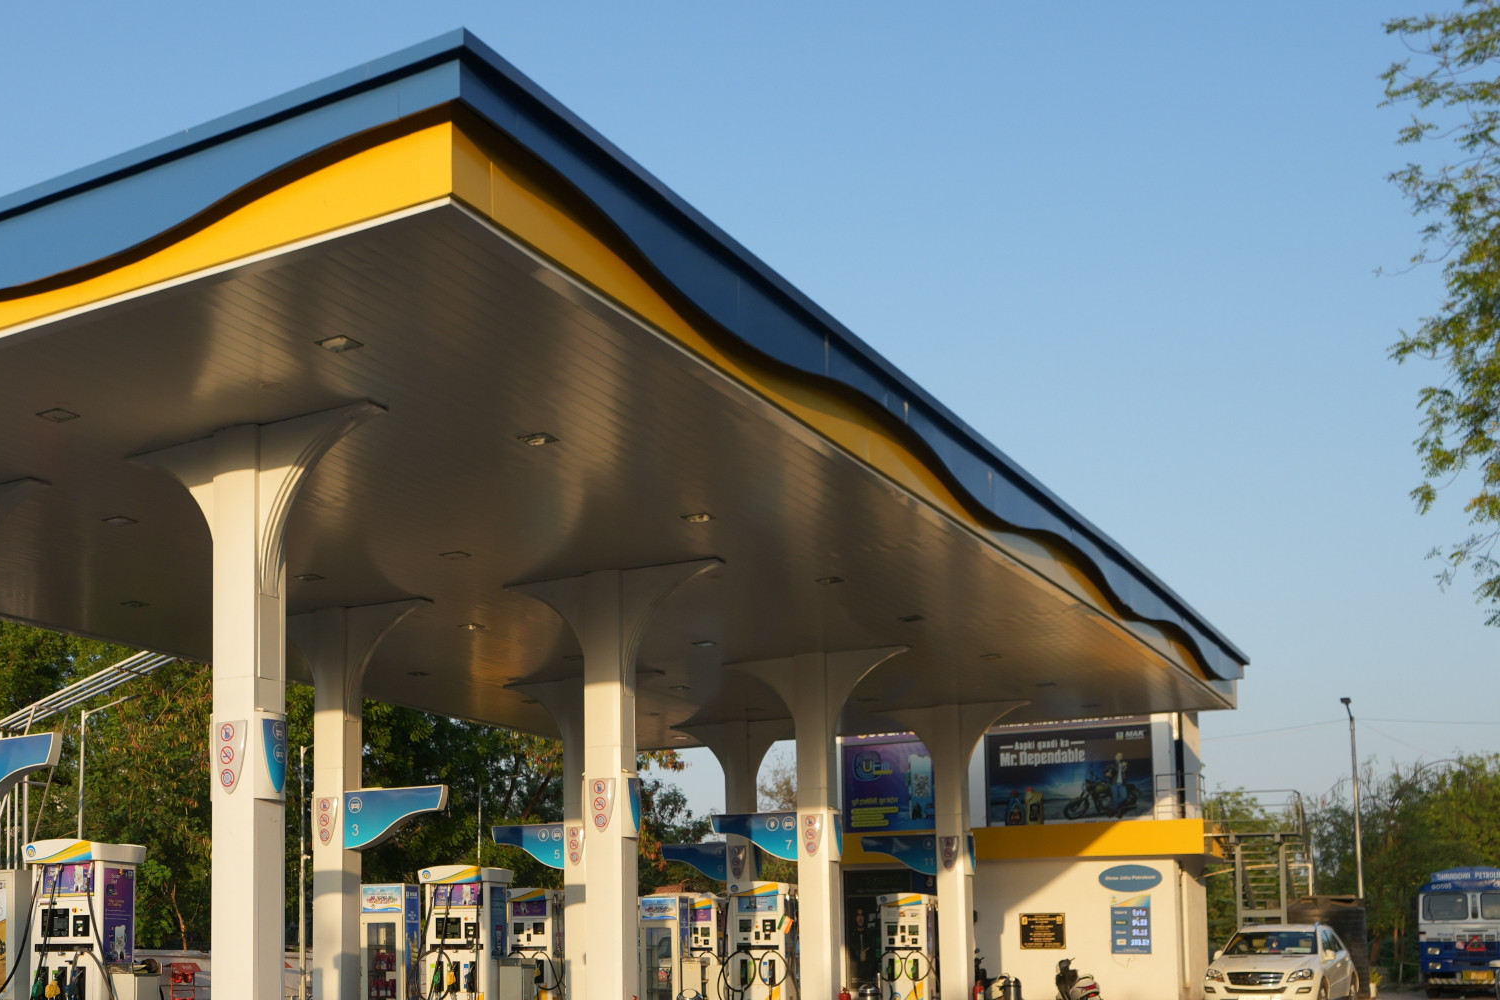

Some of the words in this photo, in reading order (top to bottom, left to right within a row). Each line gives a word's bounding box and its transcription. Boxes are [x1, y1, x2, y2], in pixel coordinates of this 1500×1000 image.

[1014, 741, 1036, 751] Aapki
[1037, 738, 1058, 750] gaadi
[1060, 738, 1070, 747] ka
[1000, 752, 1018, 767] Mr.
[1019, 748, 1086, 767] Dependable
[351, 823, 360, 837] 3
[785, 839, 793, 851] 7
[553, 850, 561, 860] 5
[923, 857, 934, 867] 11
